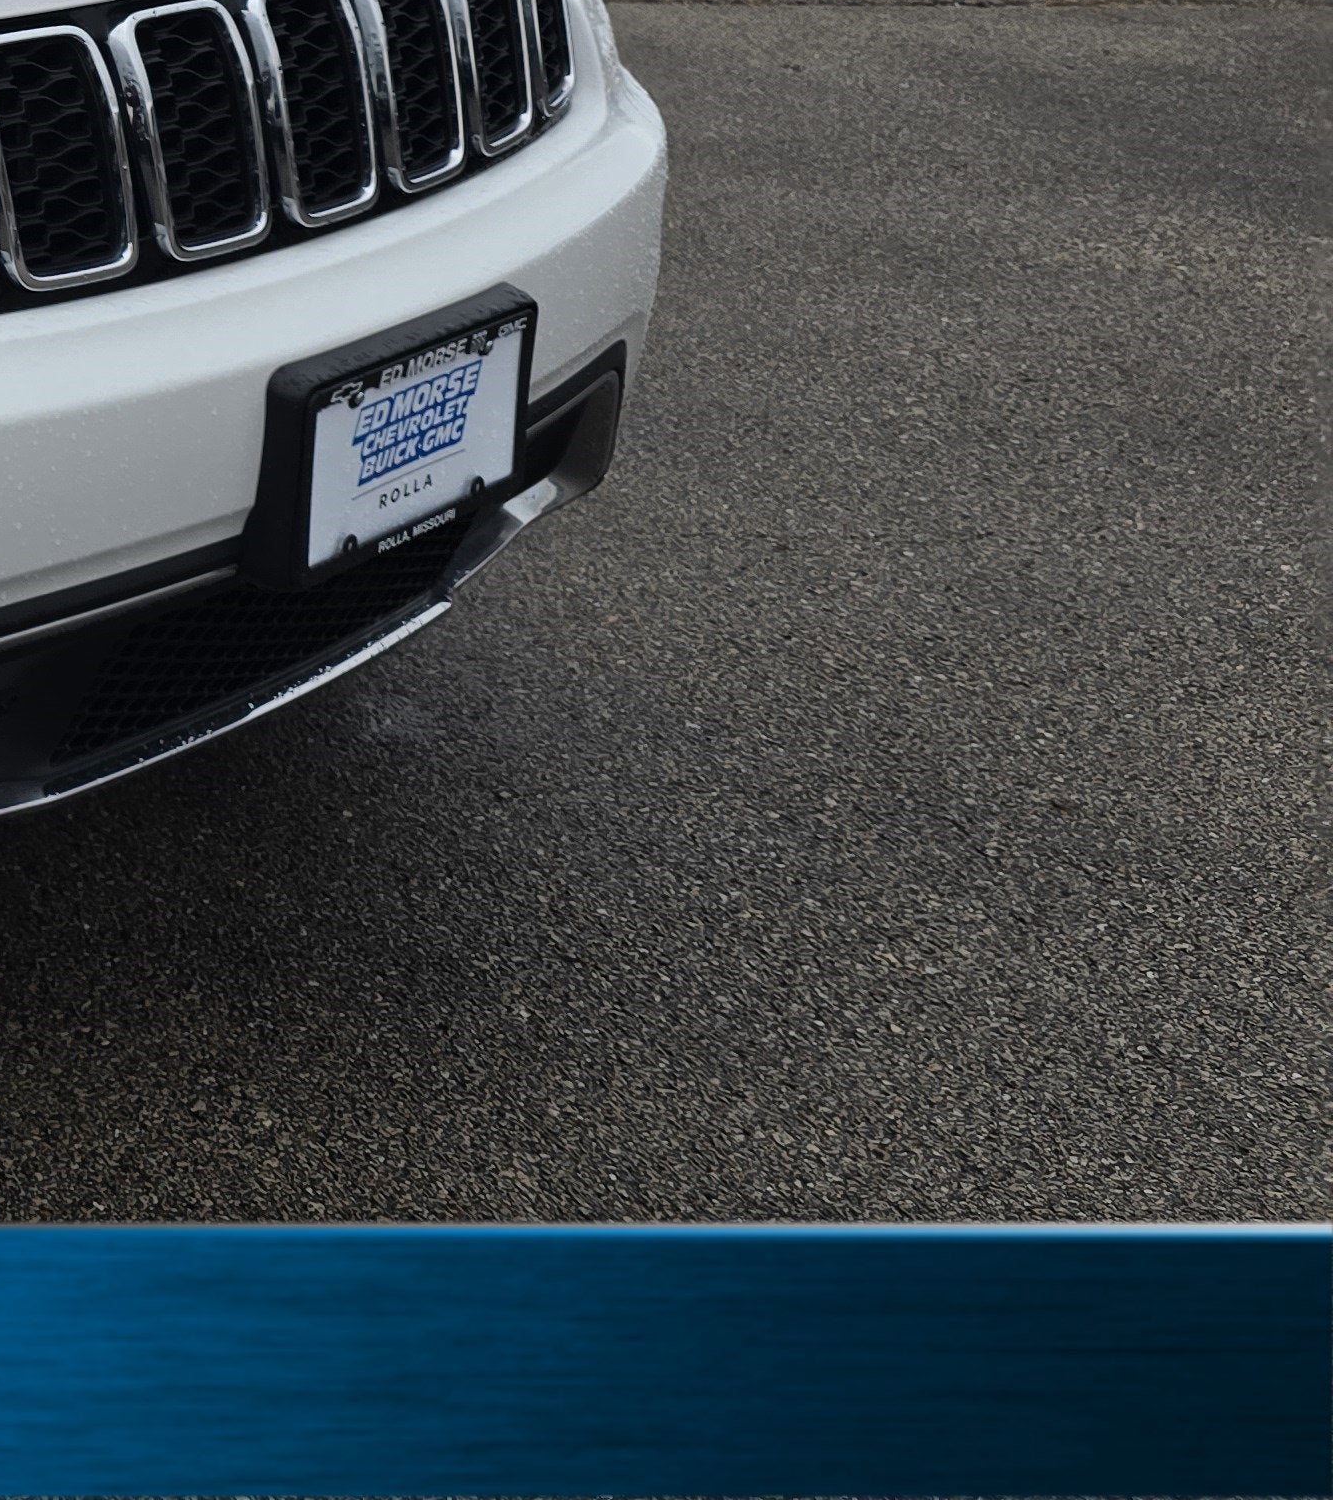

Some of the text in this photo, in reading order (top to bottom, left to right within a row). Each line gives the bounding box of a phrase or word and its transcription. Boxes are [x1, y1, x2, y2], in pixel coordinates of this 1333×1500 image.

[381, 364, 404, 385] ED
[406, 338, 468, 378] MORSE
[354, 364, 480, 439] ED MORSE
[362, 395, 469, 457] CHEVROLET
[361, 417, 465, 479] BUICK GMC
[379, 473, 433, 509] ROLLA
